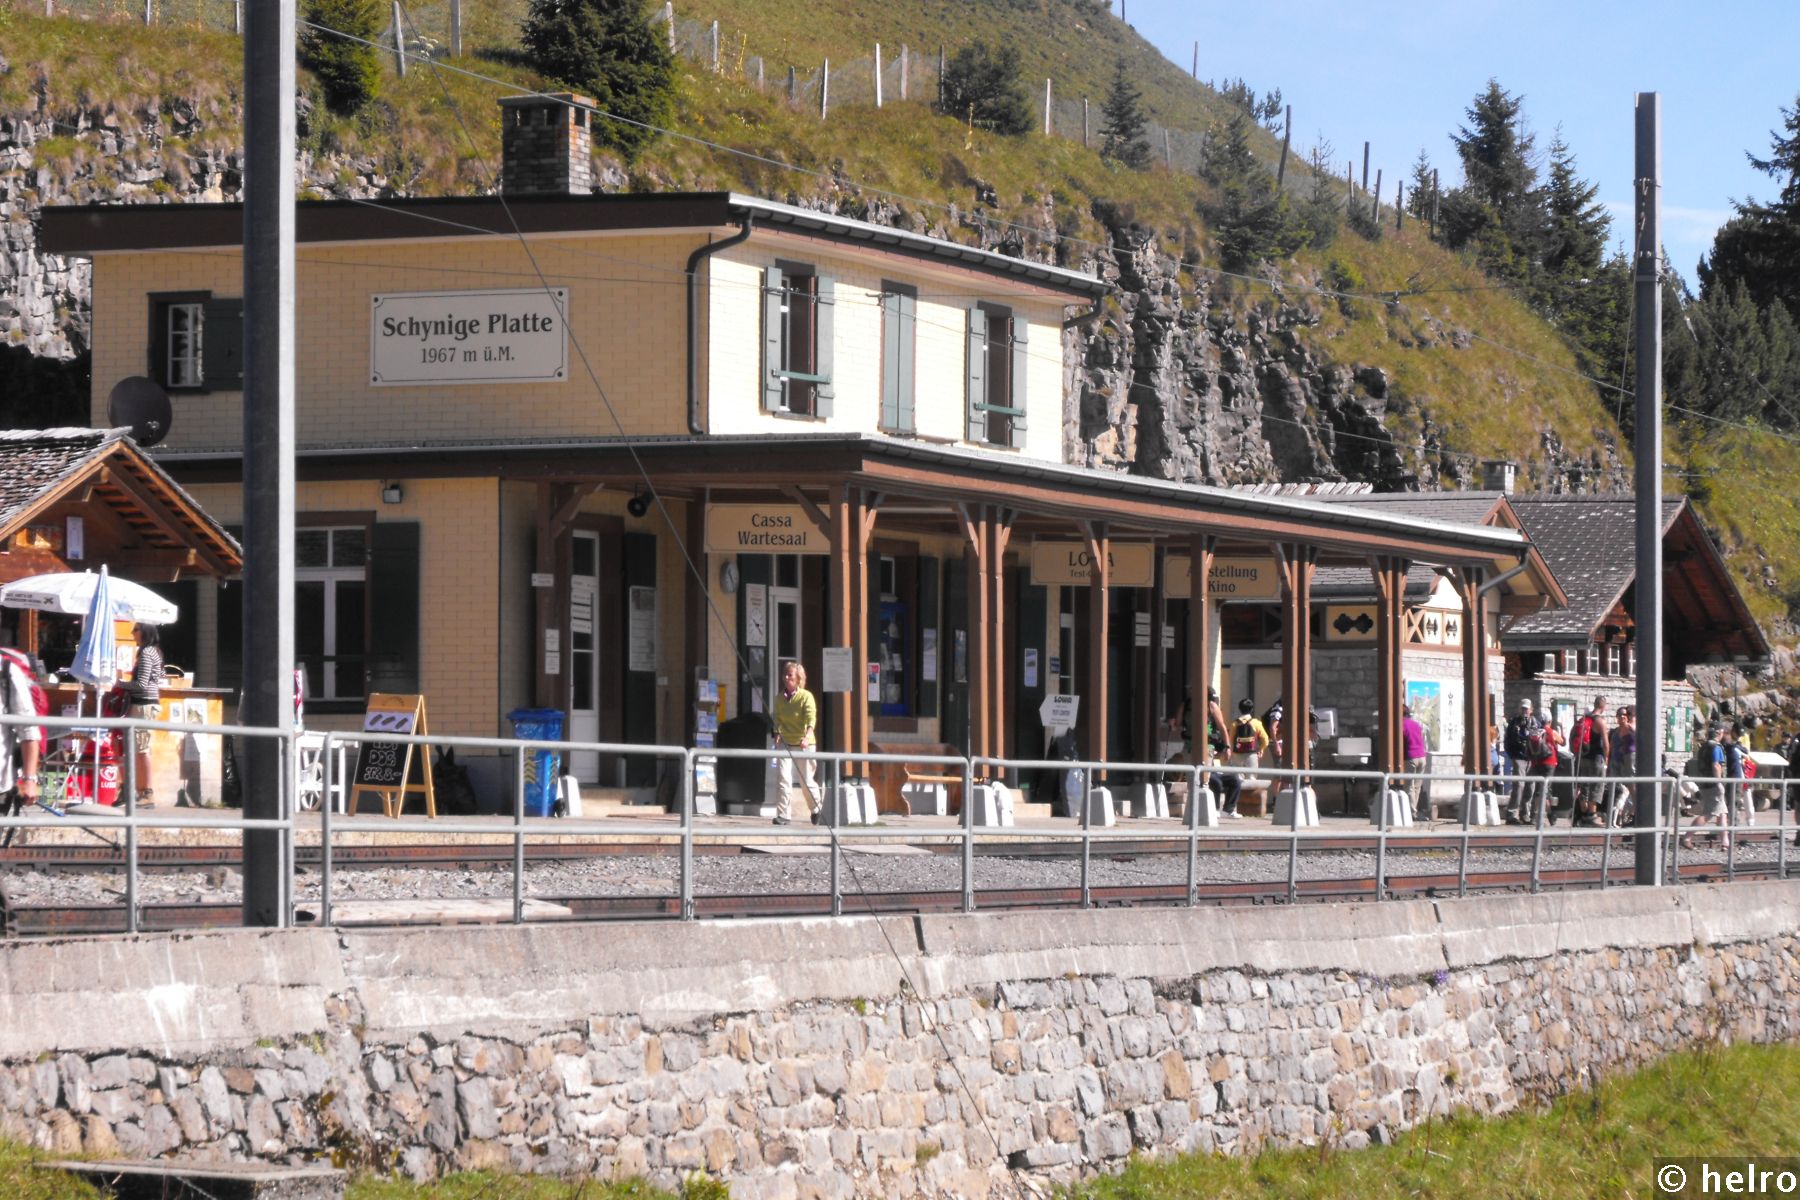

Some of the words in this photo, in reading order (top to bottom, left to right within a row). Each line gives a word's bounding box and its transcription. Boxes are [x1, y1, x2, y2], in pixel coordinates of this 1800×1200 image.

[383, 313, 480, 342] Schynige
[487, 312, 553, 334] Platte
[421, 347, 456, 363] 1967
[463, 349, 477, 362] m
[484, 346, 515, 362] ü.M.
[751, 513, 792, 528] Cassa
[738, 531, 807, 546] Wartesaal
[1069, 551, 1114, 567] LOA
[1208, 580, 1236, 593] Kino
